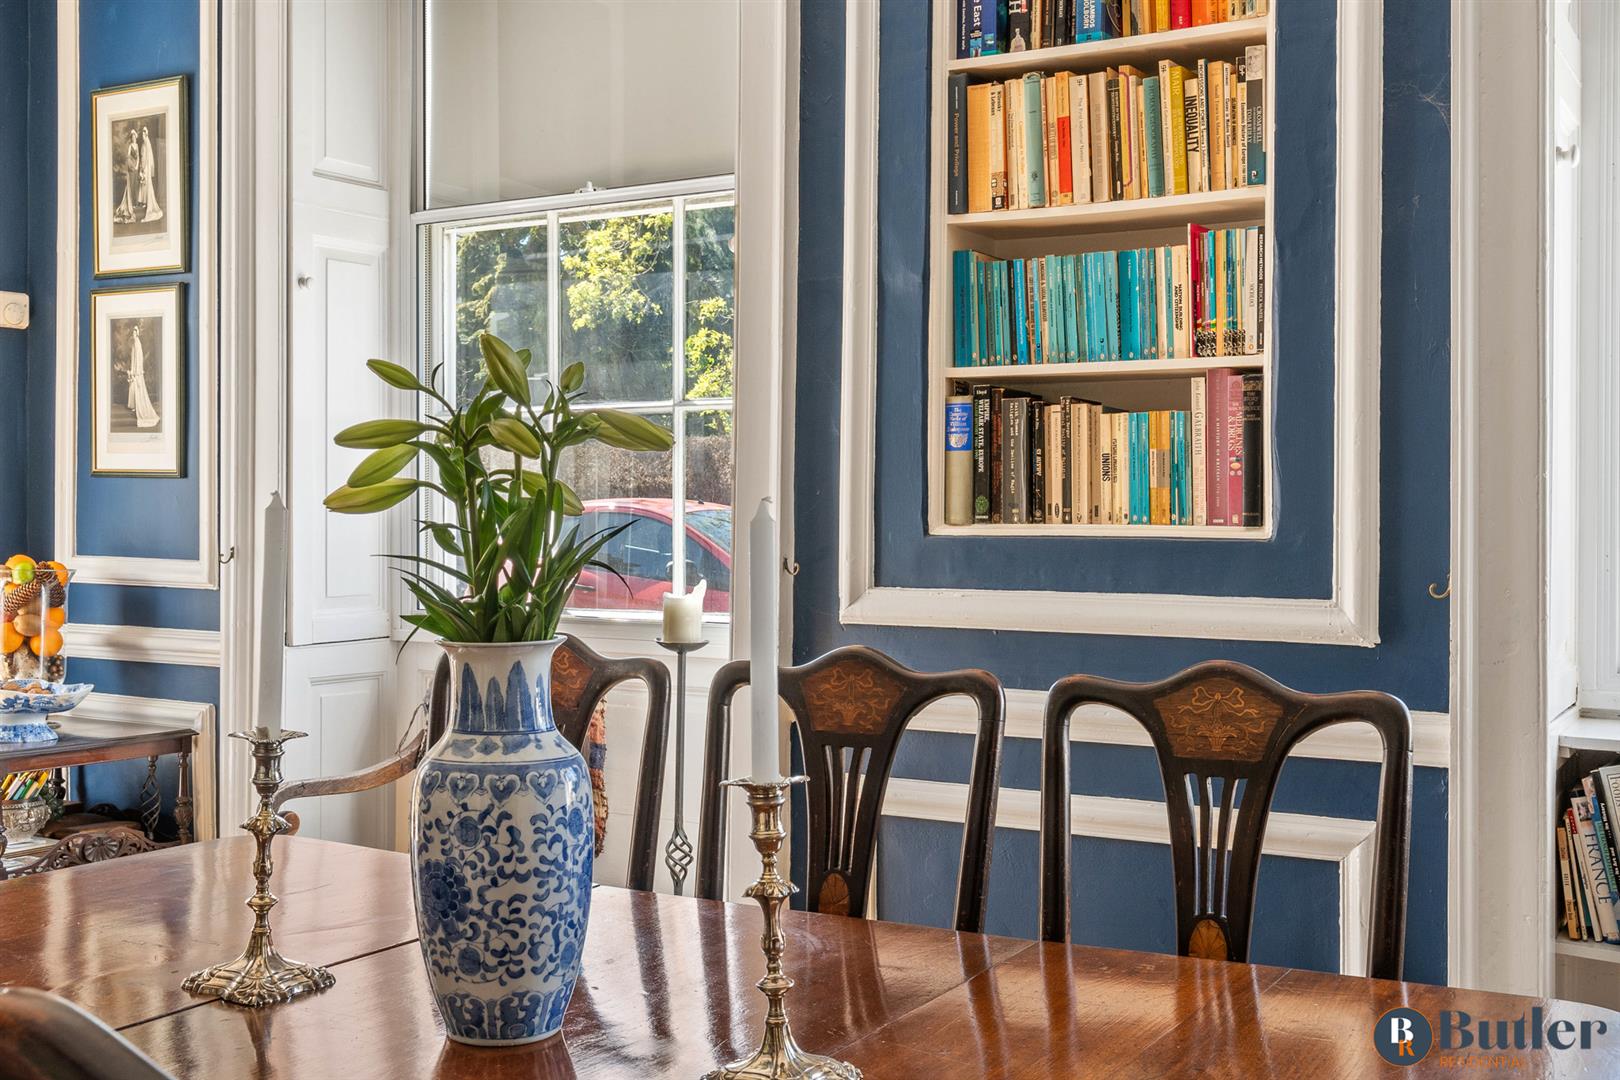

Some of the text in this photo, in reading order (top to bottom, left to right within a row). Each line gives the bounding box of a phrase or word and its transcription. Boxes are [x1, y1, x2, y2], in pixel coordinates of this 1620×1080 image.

[973, 5, 982, 27] East
[1172, 71, 1180, 95] MAIR
[1184, 95, 1199, 152] INEQUALITY
[1194, 412, 1204, 455] GALBRAITH
[1101, 453, 1110, 481] UNIONS
[1585, 833, 1612, 905] FRANCE
